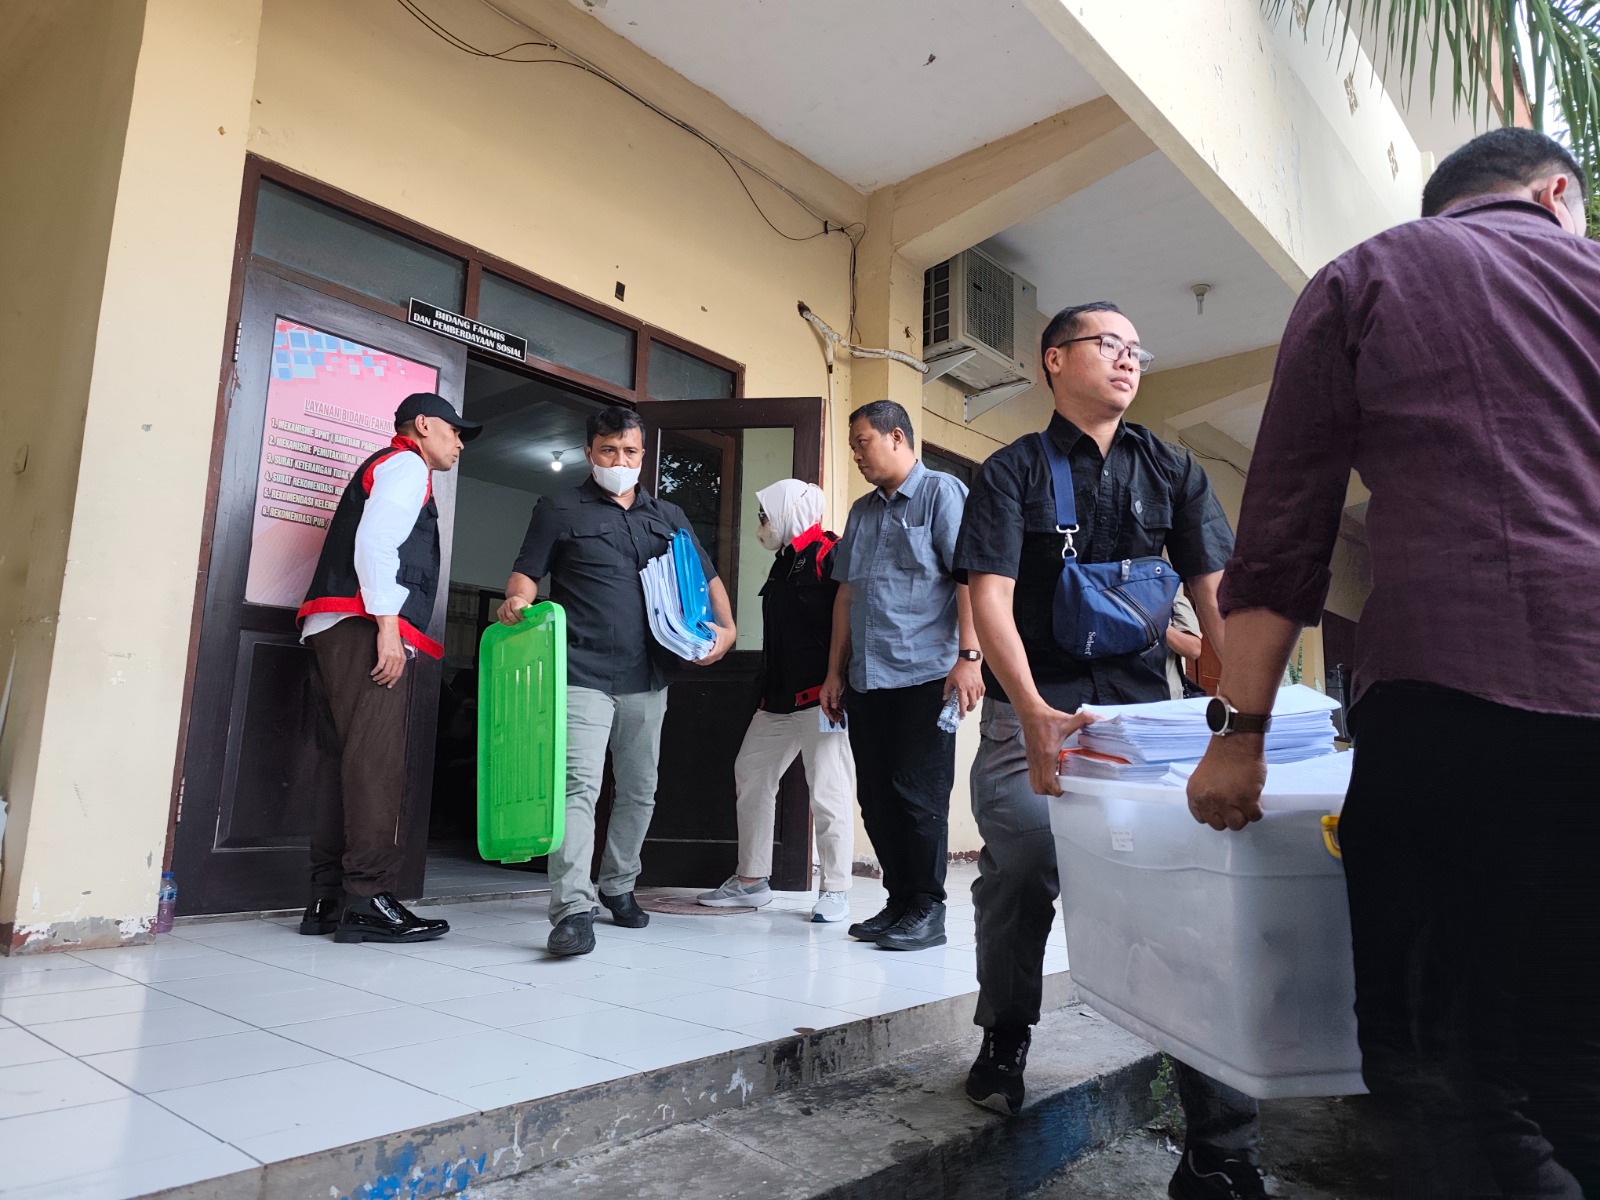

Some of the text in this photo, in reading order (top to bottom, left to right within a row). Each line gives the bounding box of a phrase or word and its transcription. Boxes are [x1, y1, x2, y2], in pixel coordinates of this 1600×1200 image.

[413, 312, 522, 358] DAN PEMBERDAYAAN SOSIAL
[435, 310, 505, 342] BIDANG FAKMIS
[271, 418, 277, 428] 1.
[278, 420, 314, 436] MEKANISME
[314, 427, 330, 439] BPNT
[304, 399, 396, 434] LAYANAN BIDANG FAKMI
[268, 435, 275, 445] 2.
[276, 437, 312, 454] MEKANISME
[313, 446, 357, 465] PEMUTAKHIRAN
[266, 453, 273, 463] 3.
[274, 455, 293, 468] SURAT
[294, 459, 332, 476] KETERANGAN
[333, 468, 350, 480] TIDAK
[264, 471, 271, 481] 4.
[272, 472, 292, 486] SURAT
[292, 477, 334, 494] REKOMENDASI
[271, 490, 314, 507] REKOMENDASI
[314, 499, 339, 510] KELEMB
[269, 507, 312, 525] REKOMENDASI
[312, 517, 325, 527] PUB
